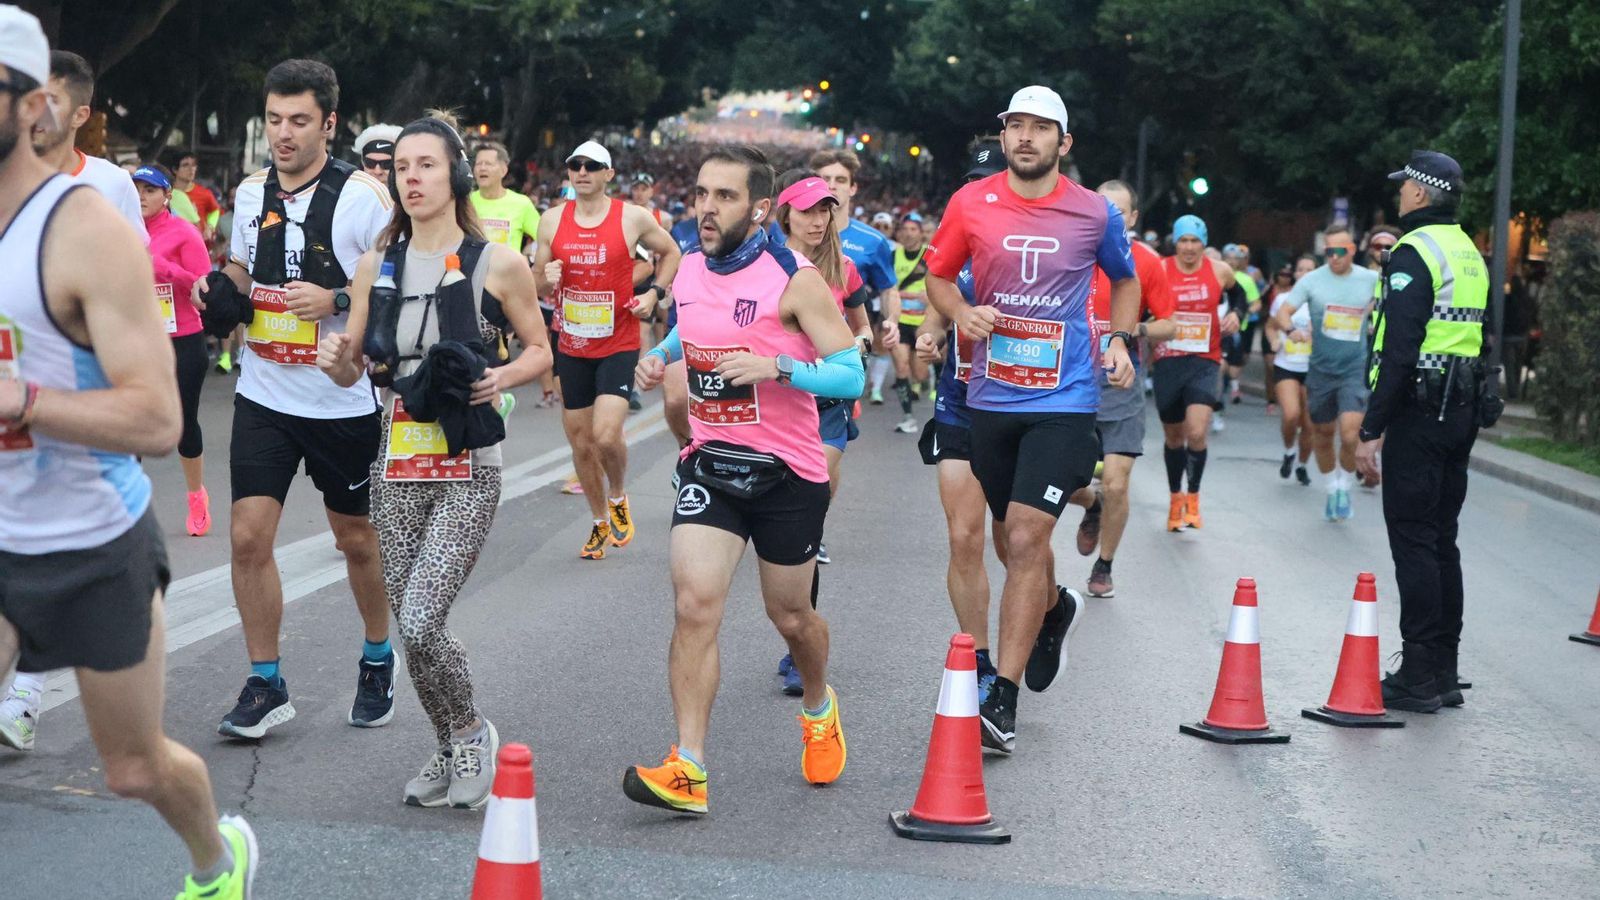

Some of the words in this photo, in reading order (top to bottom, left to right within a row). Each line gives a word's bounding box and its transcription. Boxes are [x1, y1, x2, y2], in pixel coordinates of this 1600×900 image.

[570, 254, 597, 264] MÁLAGA
[575, 294, 609, 302] GENERALI
[993, 292, 1062, 307] TRENARA
[264, 316, 297, 332] 1098
[1007, 320, 1058, 335] GENERALI
[1006, 341, 1041, 357] 7490
[697, 374, 725, 390] 123
